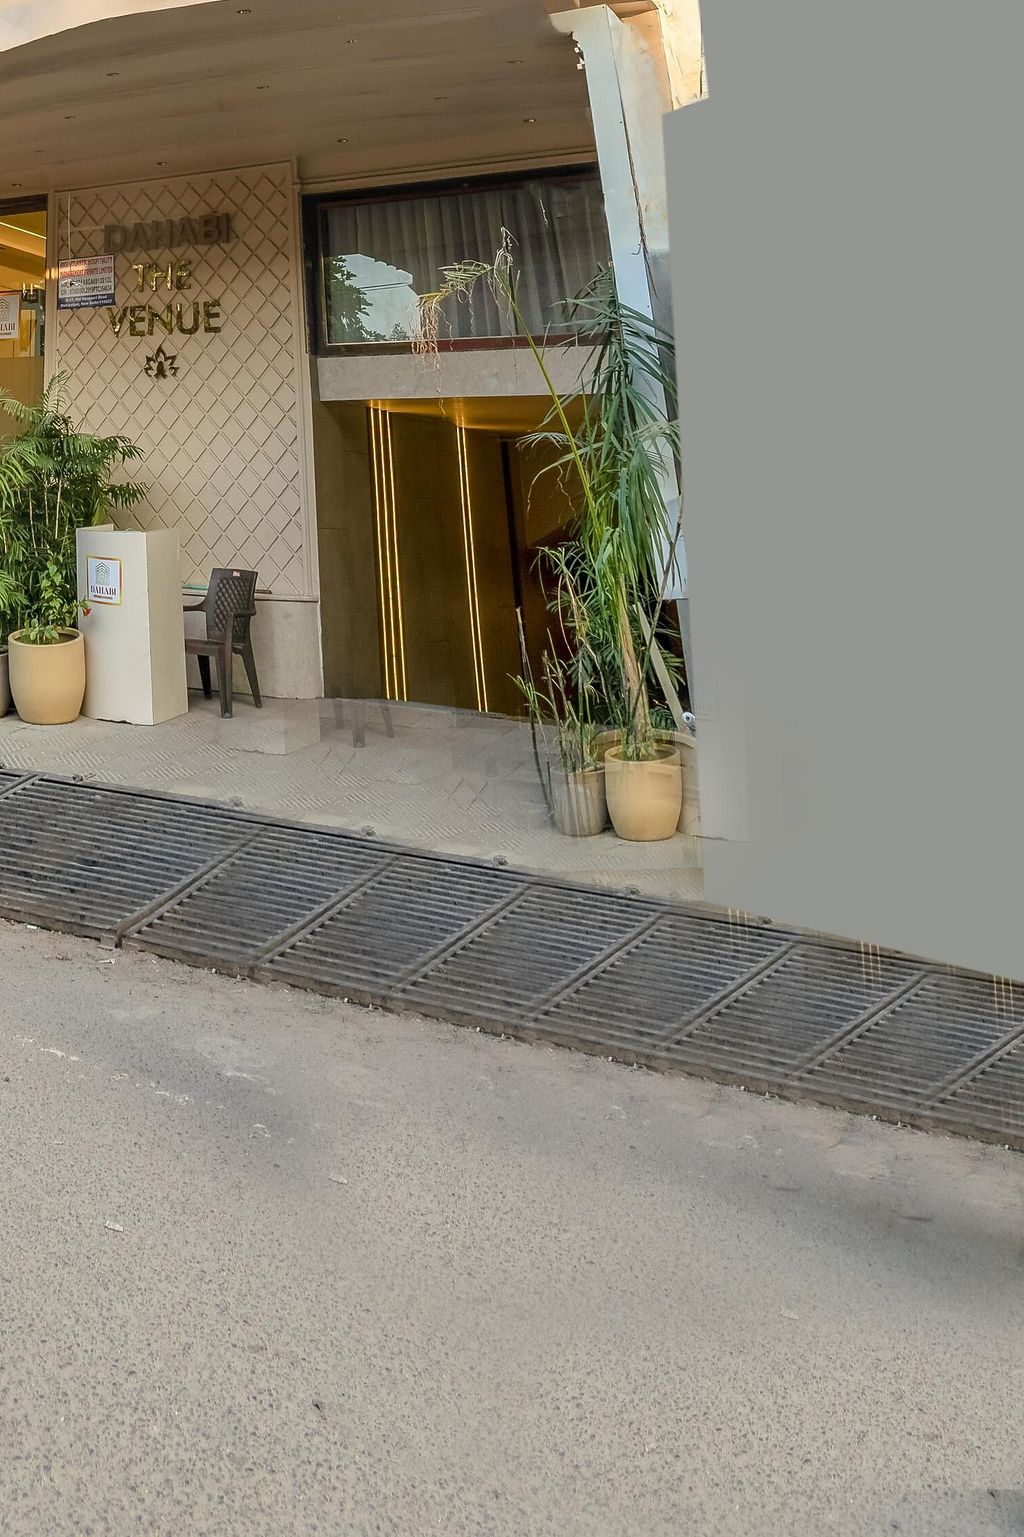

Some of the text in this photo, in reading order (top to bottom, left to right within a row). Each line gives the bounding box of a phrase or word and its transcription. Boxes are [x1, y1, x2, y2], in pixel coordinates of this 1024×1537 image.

[104, 212, 229, 252] DAHABI
[132, 259, 192, 293] THE
[106, 300, 222, 338] VENUE
[91, 585, 117, 595] DAHABI
